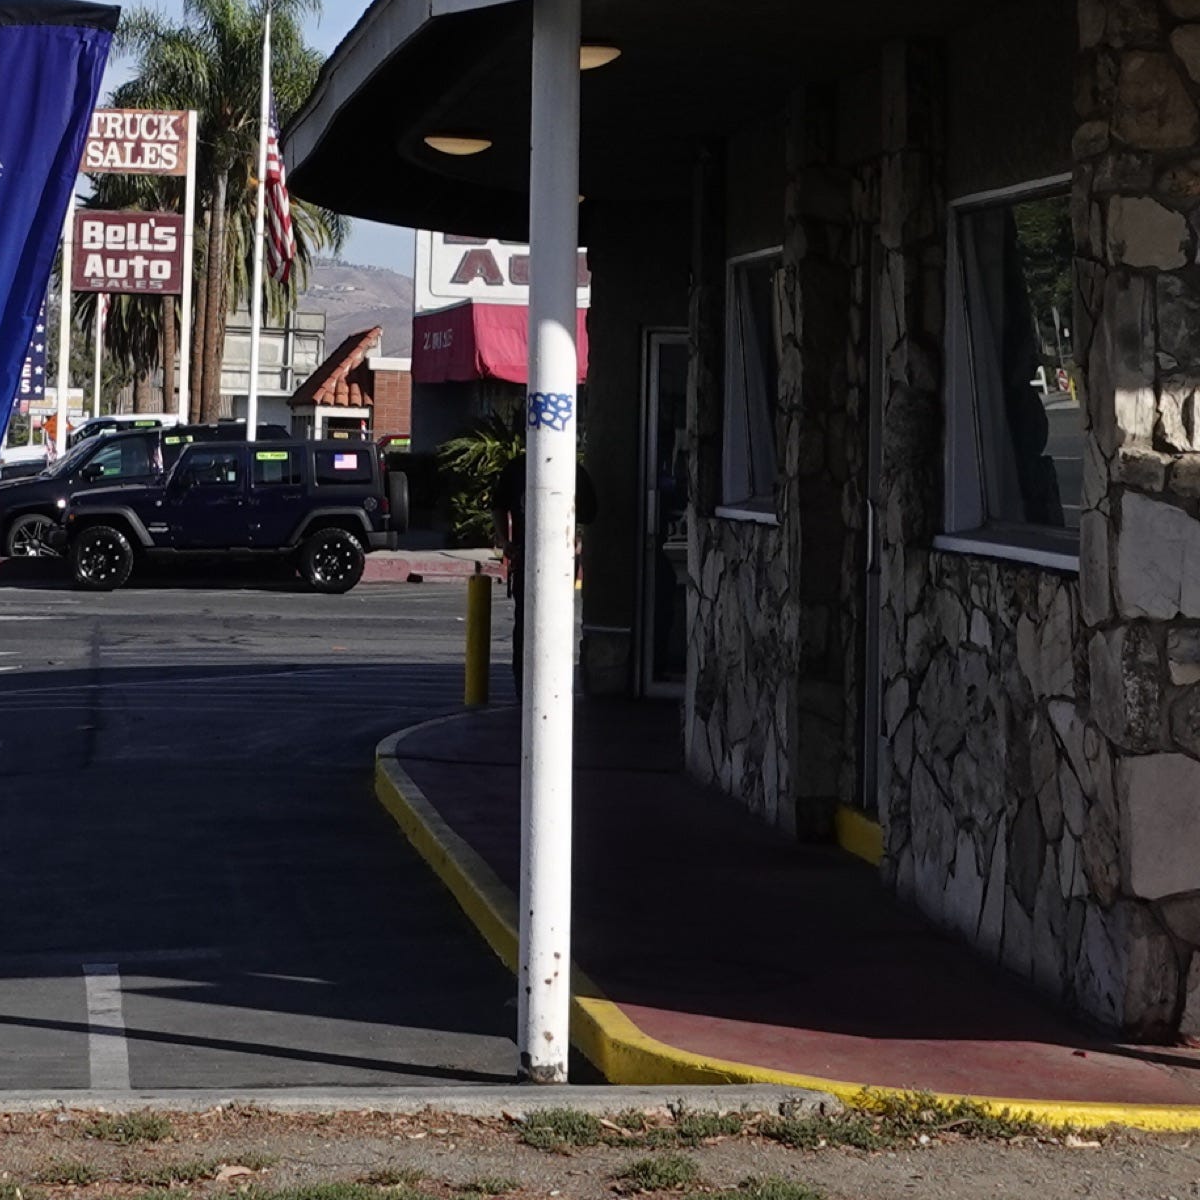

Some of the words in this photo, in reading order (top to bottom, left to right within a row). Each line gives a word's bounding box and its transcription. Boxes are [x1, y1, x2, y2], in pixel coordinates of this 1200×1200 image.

[89, 112, 180, 141] TRUCK
[86, 140, 178, 170] SALES
[82, 217, 177, 253] Bell's
[83, 253, 172, 280] Auto
